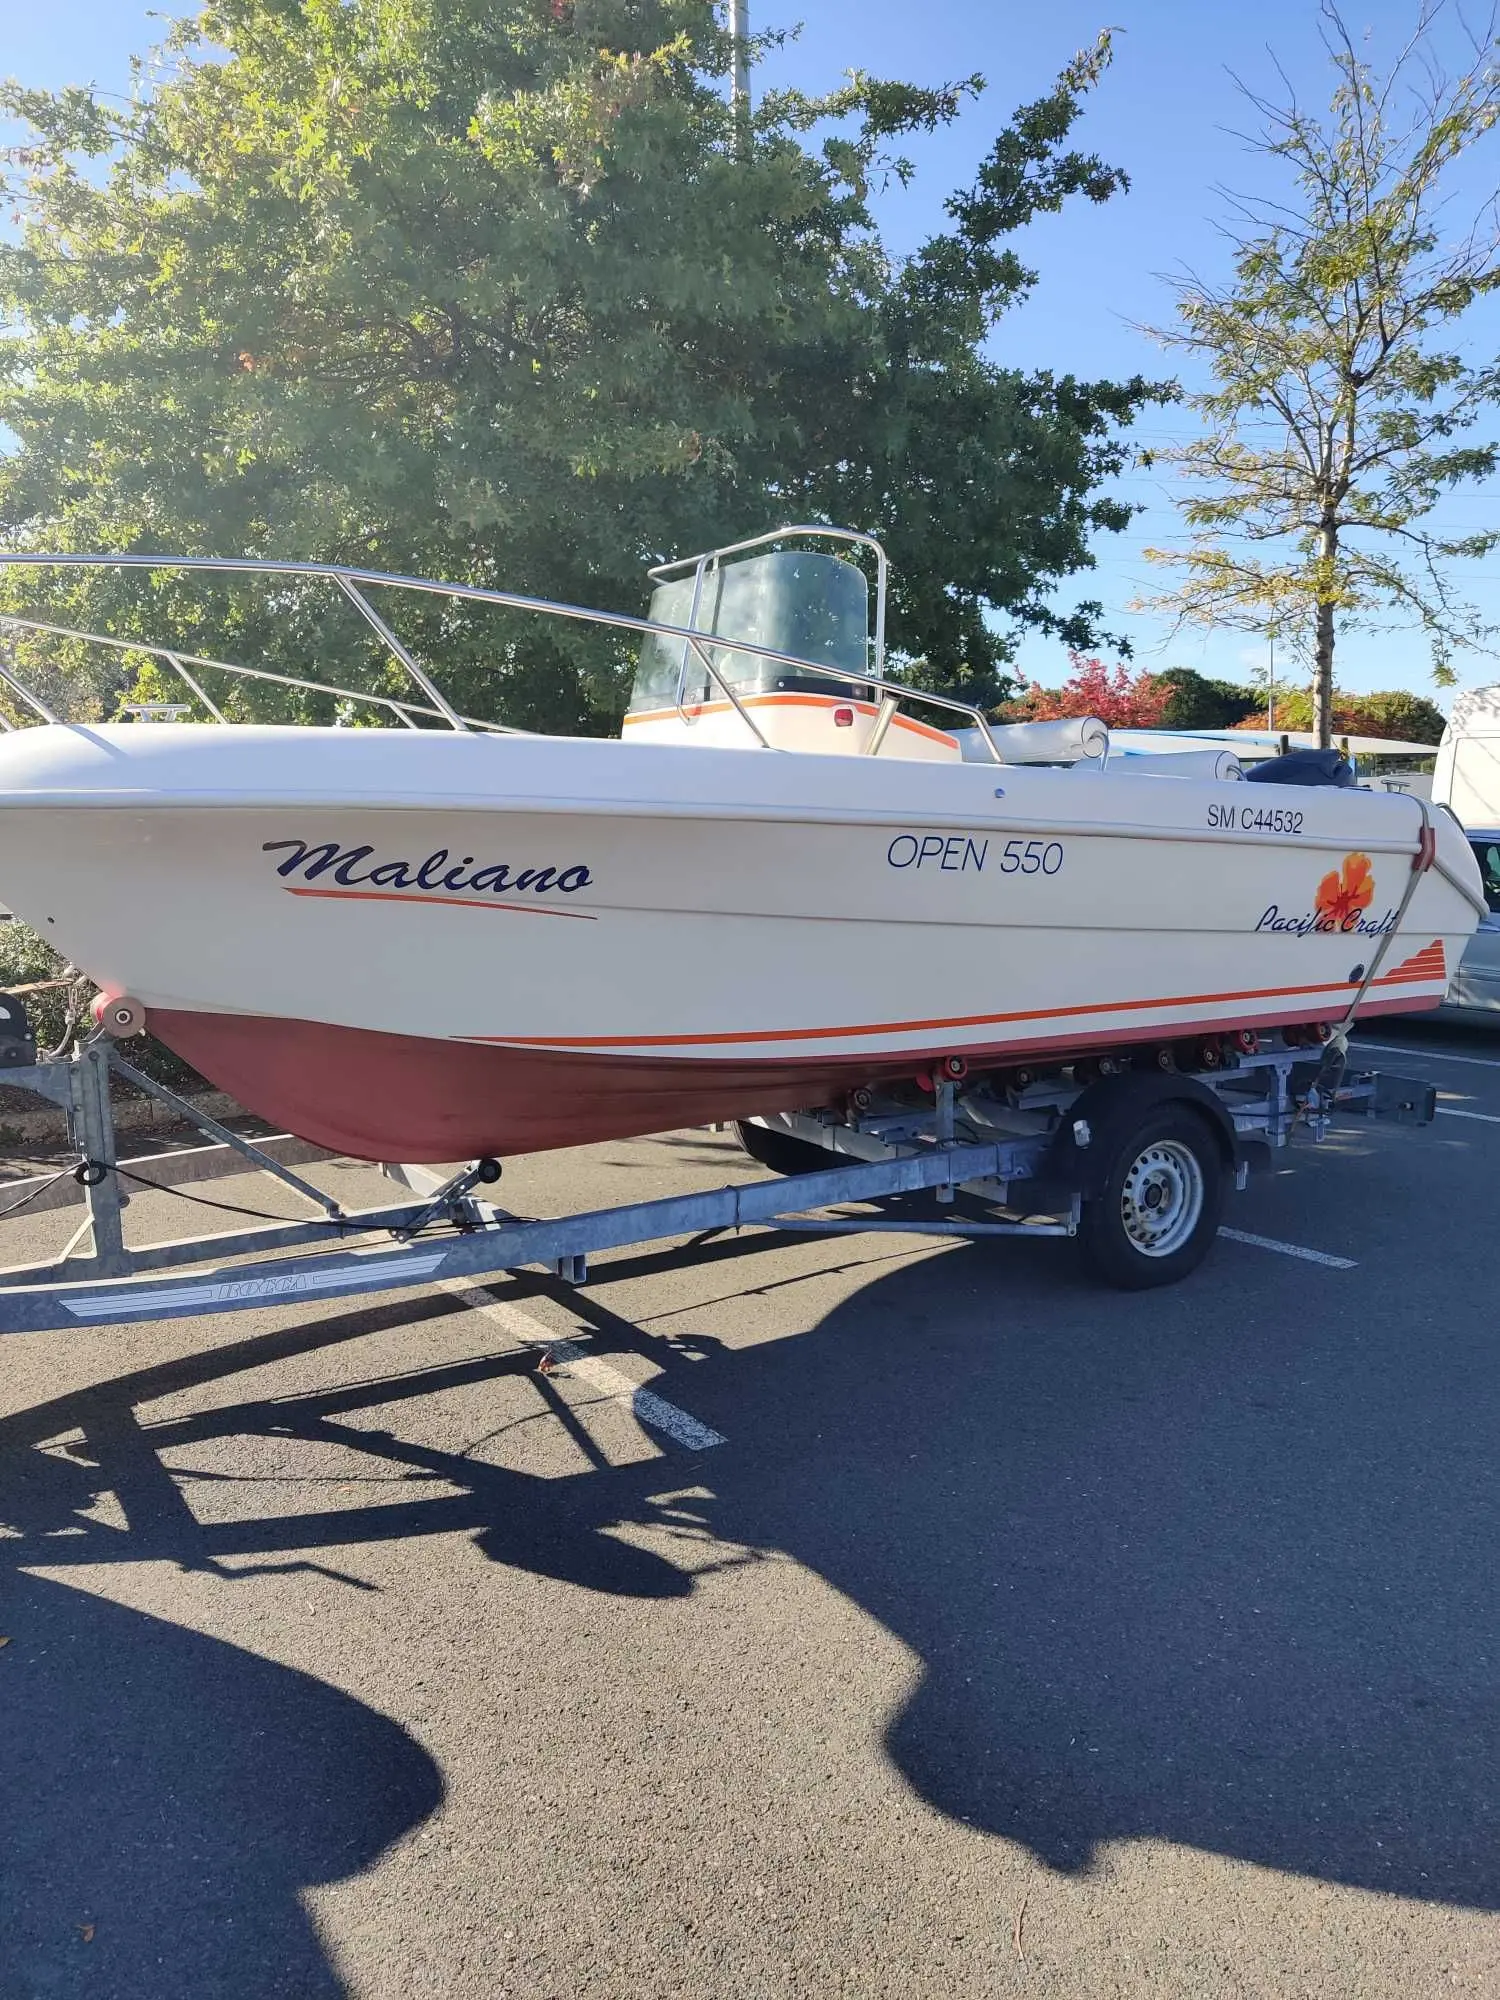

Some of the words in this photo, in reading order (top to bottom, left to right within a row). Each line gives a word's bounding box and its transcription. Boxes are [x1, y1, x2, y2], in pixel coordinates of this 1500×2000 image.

[1208, 804, 1235, 828] SM
[1241, 808, 1303, 833] C44532
[262, 840, 594, 893] Maliano
[887, 835, 989, 872] OPEN
[1000, 840, 1064, 875] 550
[1254, 904, 1335, 938] Pacific
[1341, 907, 1400, 939] Craft
